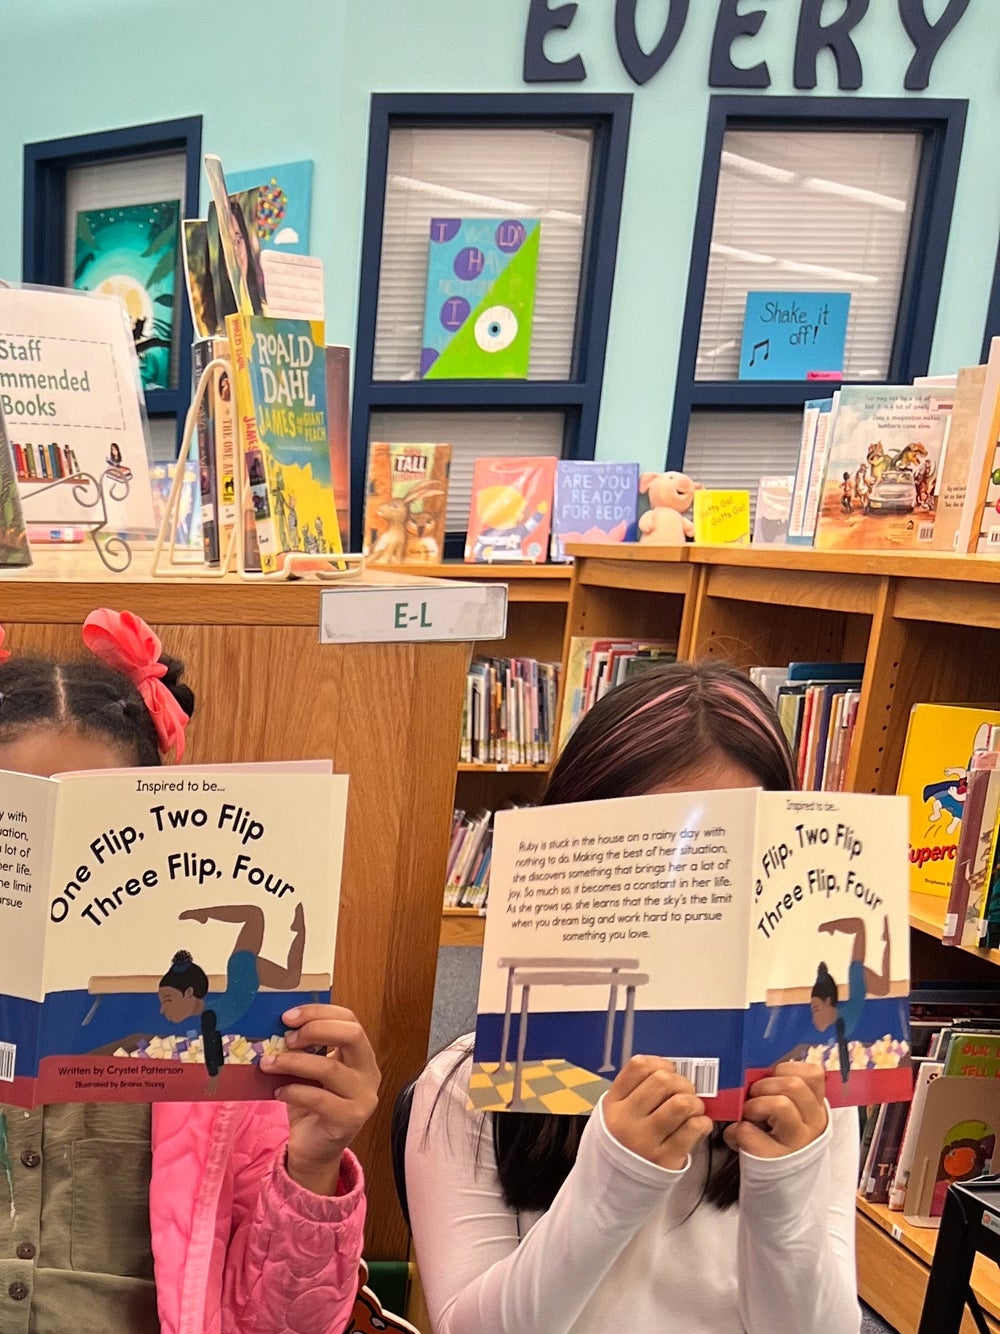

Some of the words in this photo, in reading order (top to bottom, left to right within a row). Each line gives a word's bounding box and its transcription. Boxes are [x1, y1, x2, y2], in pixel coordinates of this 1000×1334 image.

[523, 0, 970, 91] EVERY
[760, 301, 808, 324] Shake
[818, 303, 830, 326] it
[788, 324, 819, 346] off!
[256, 333, 314, 368] ROALD
[0, 368, 90, 392] mmended
[261, 369, 316, 407] DAHL
[1, 394, 57, 417] Books
[222, 418, 233, 436] THE
[258, 405, 297, 438] JAMES
[243, 416, 259, 453] JAMES
[222, 440, 234, 459] ONE
[396, 456, 426, 472] TALL
[562, 474, 593, 489] ARE
[598, 474, 631, 490] YOU
[572, 489, 624, 505] READY
[562, 504, 590, 520] FOR
[596, 505, 632, 521] BED?
[394, 602, 432, 629] E-L
[136, 780, 184, 795] Inspired
[188, 781, 199, 791] to
[202, 780, 225, 791] be...
[8, 811, 28, 823] with
[4, 842, 18, 856] lot
[18, 848, 31, 858] of
[762, 840, 794, 879] Flip,
[795, 823, 830, 849] Two
[835, 822, 864, 861] Flip
[907, 843, 958, 868] uperc
[16, 862, 31, 876] life.
[50, 865, 91, 923] One
[89, 826, 145, 864] Flip,
[149, 805, 208, 832] Two
[217, 803, 264, 845] Flip
[13, 880, 32, 893] limit
[80, 869, 159, 926] Three
[167, 852, 222, 885] Flip,
[232, 854, 295, 898] Four
[757, 879, 803, 940] Three
[807, 868, 842, 896] Flip,
[846, 869, 884, 911] Four
[58, 1067, 90, 1075] Written
[94, 1066, 104, 1076] by
[107, 1066, 138, 1076] Crystel
[141, 1065, 184, 1076] Patterson
